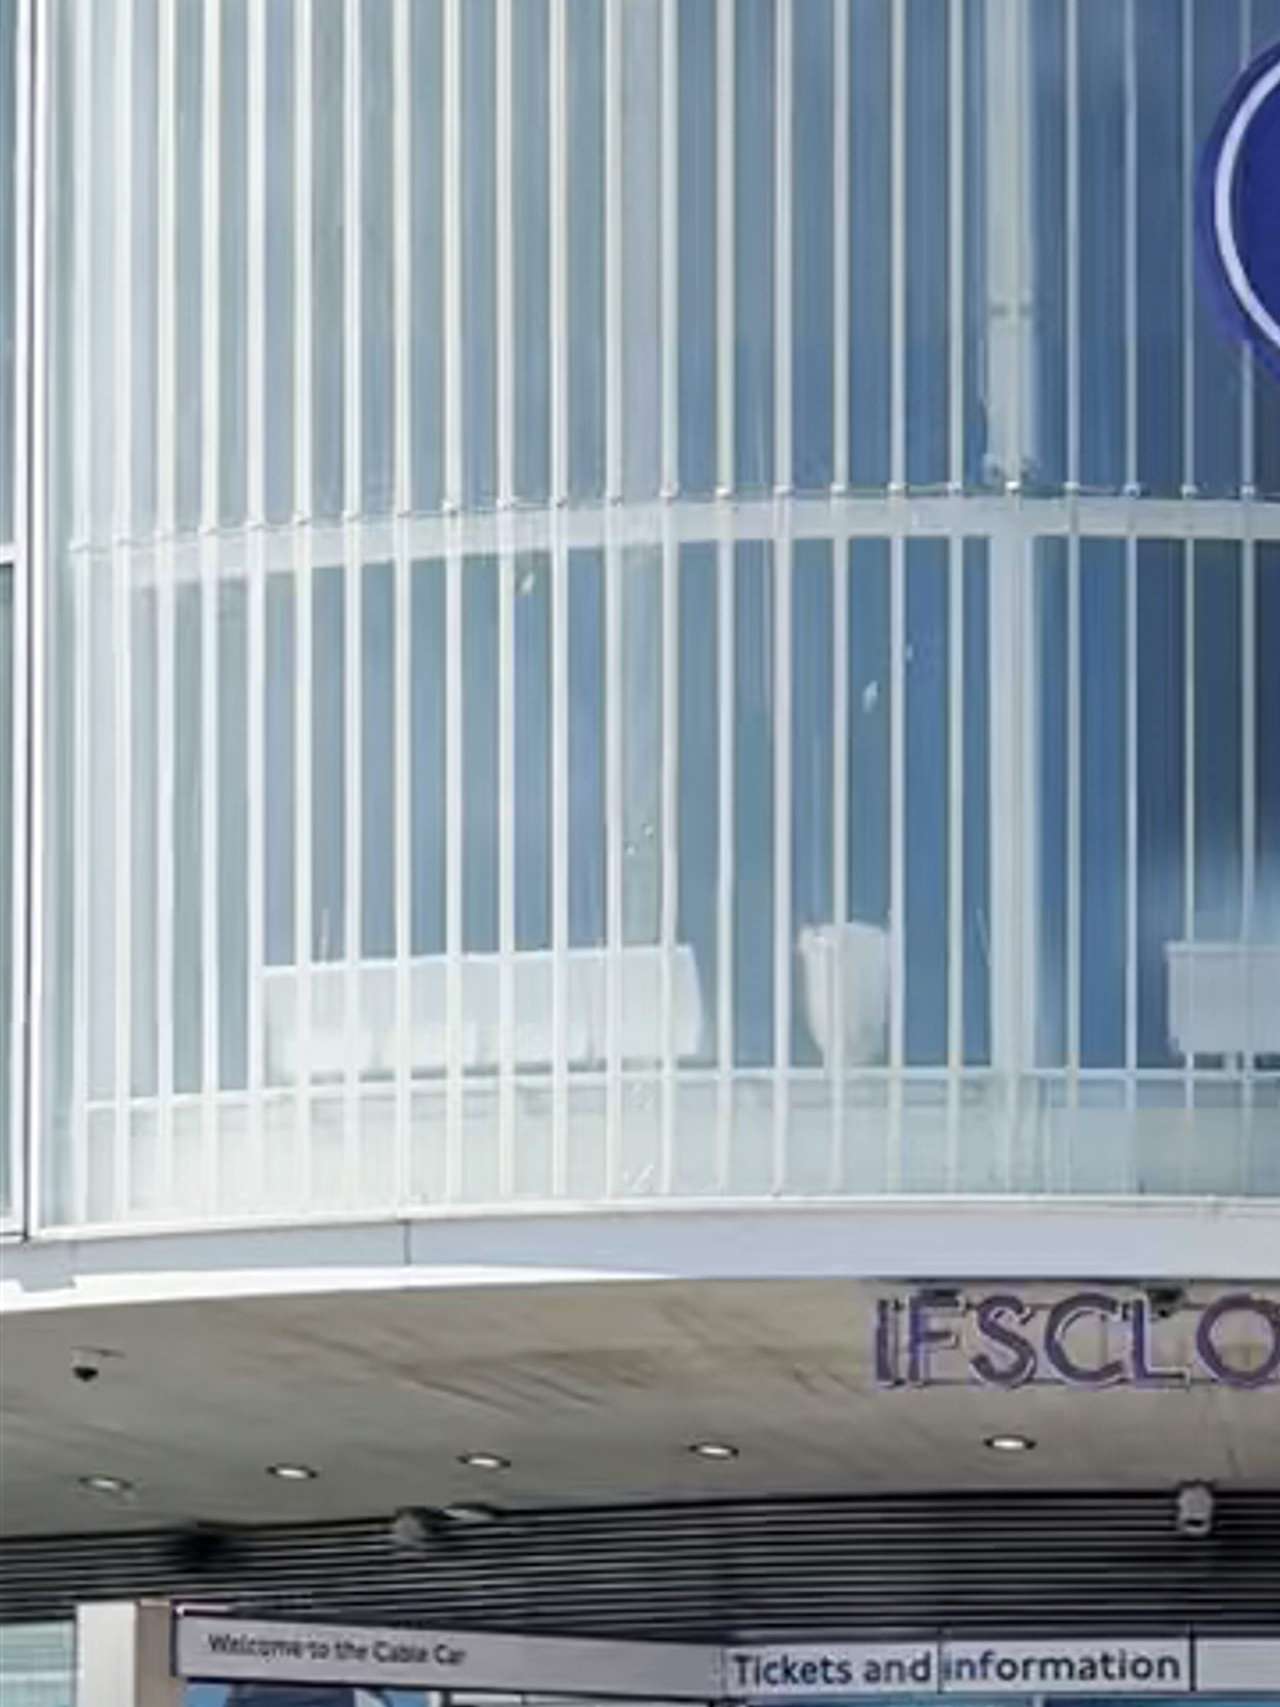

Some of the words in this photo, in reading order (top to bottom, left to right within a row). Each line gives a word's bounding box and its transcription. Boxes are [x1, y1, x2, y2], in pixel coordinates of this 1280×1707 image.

[207, 1633, 303, 1660] Welcome
[309, 1642, 330, 1660] to
[335, 1640, 368, 1661] the
[372, 1641, 429, 1664] Cable
[433, 1643, 466, 1665] Car
[733, 1653, 852, 1686] Tickets
[864, 1650, 932, 1683] and
[942, 1648, 1181, 1681] information
